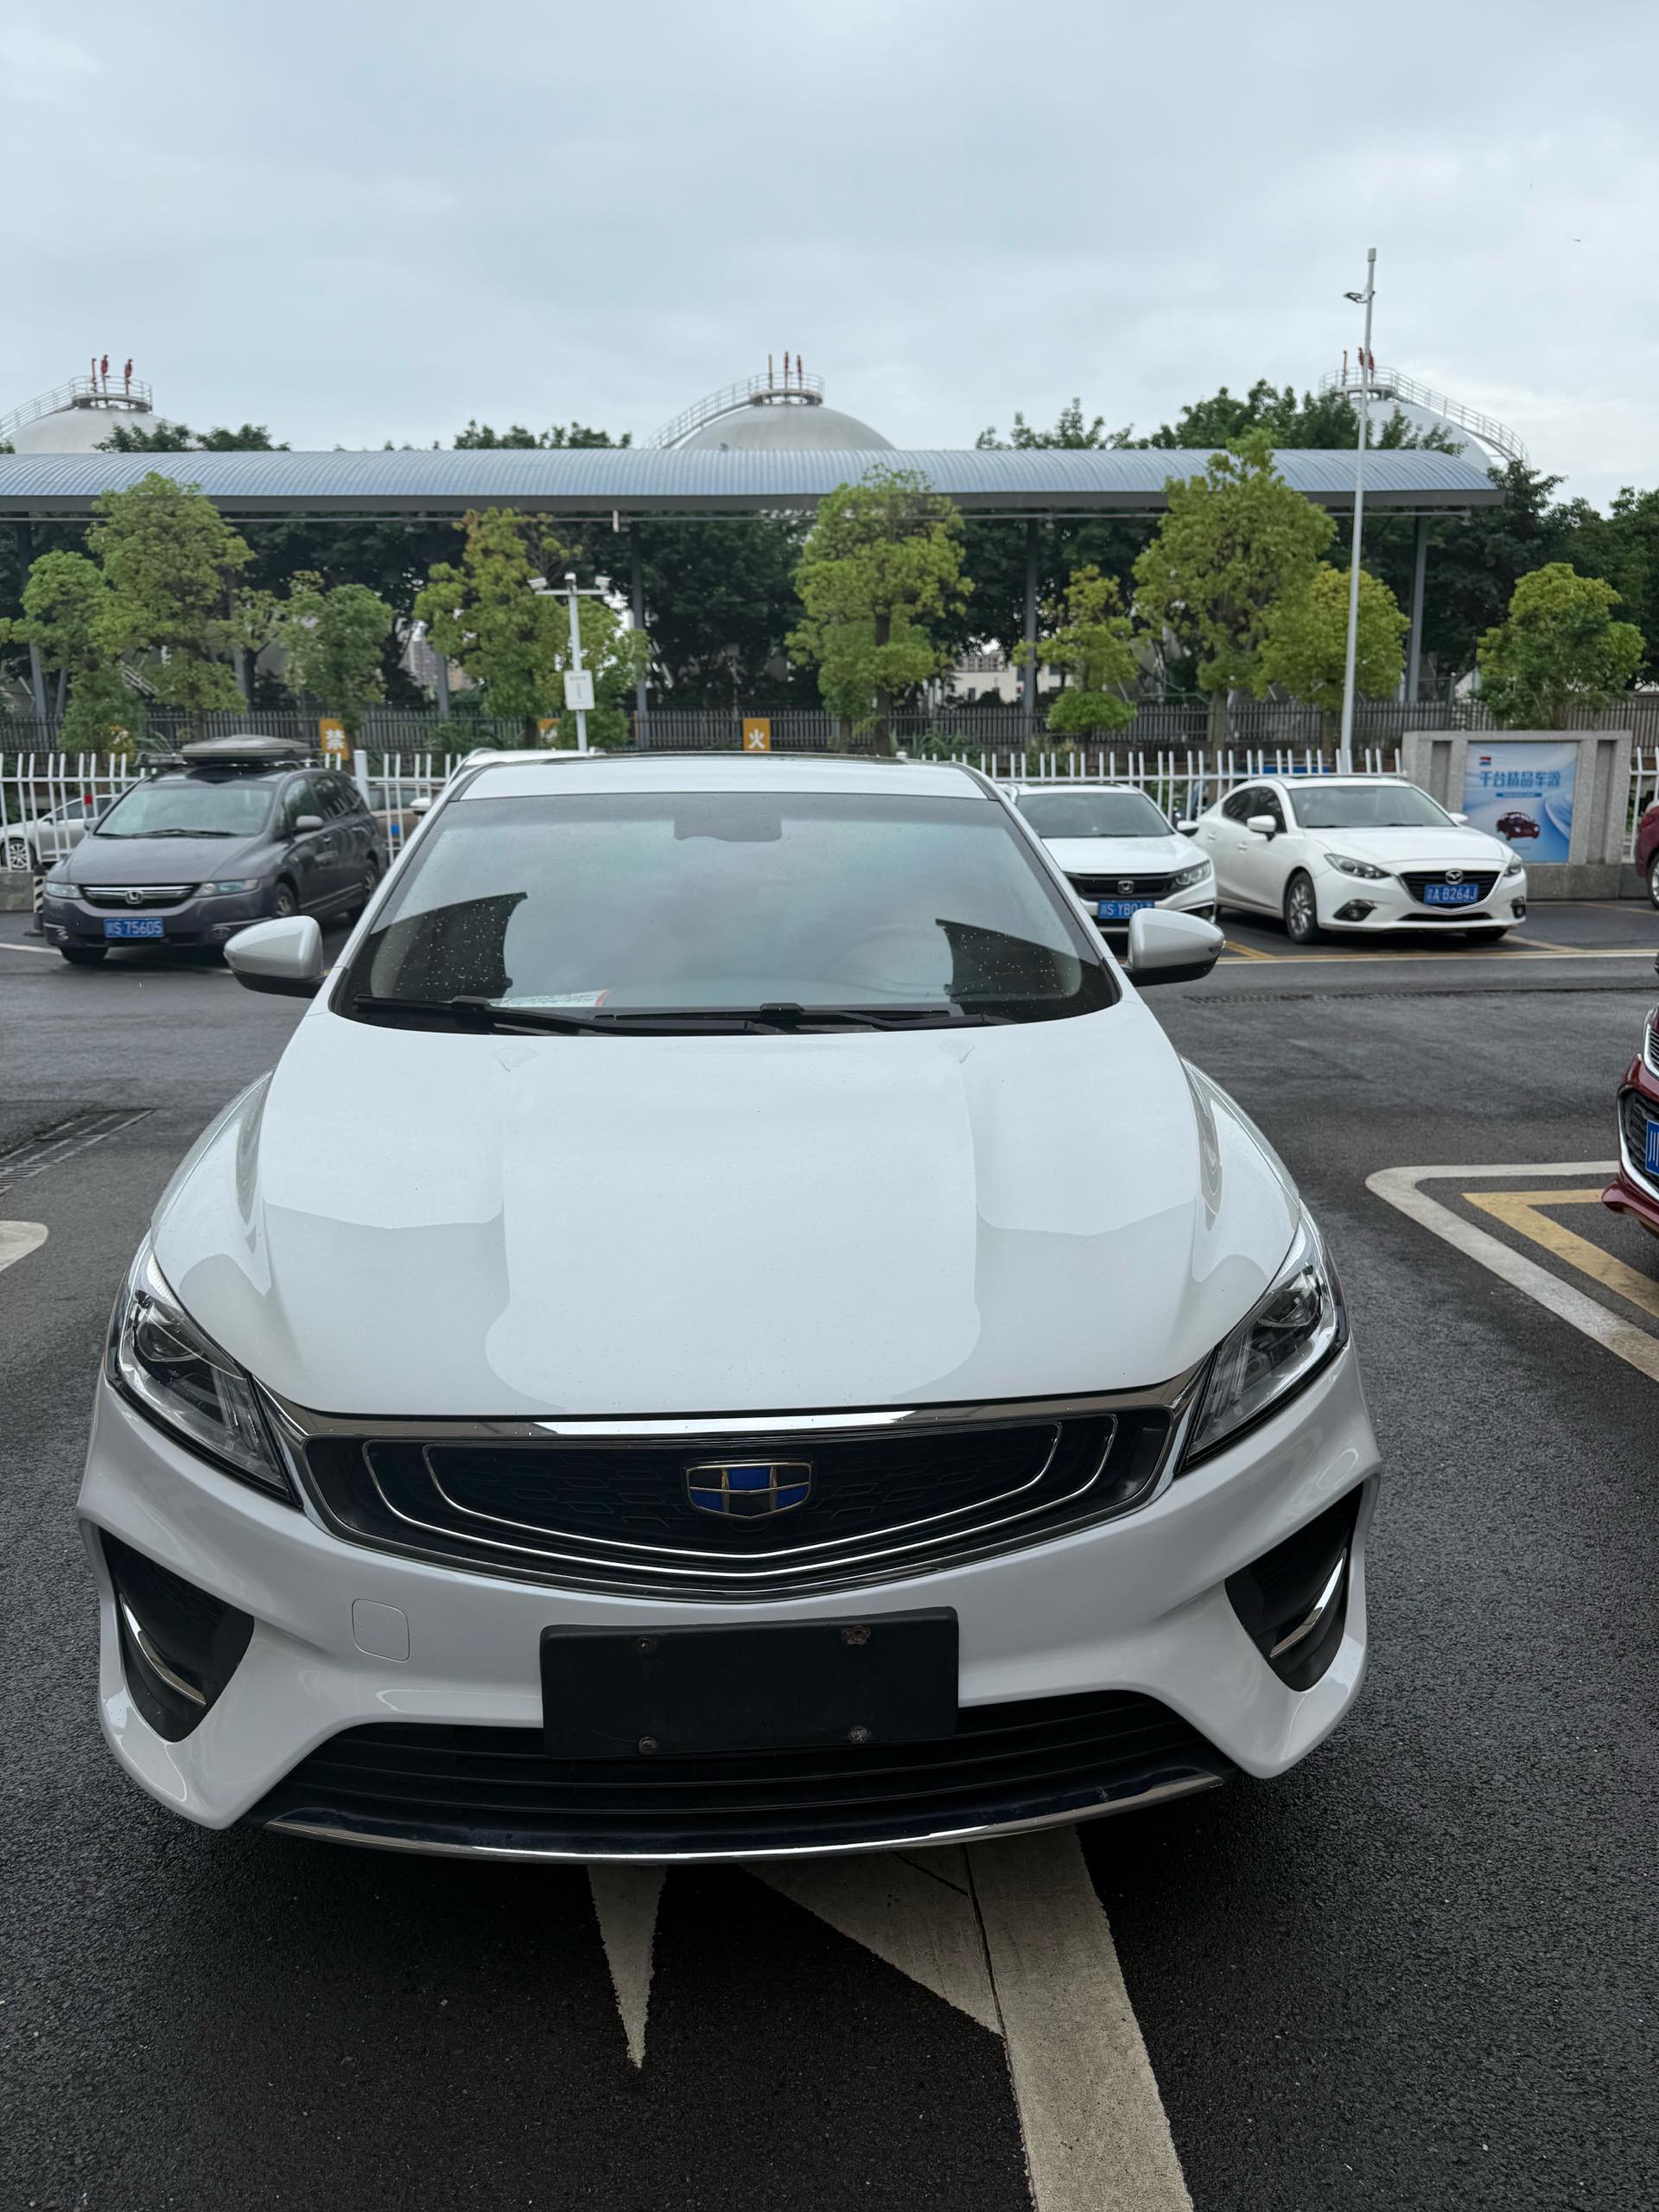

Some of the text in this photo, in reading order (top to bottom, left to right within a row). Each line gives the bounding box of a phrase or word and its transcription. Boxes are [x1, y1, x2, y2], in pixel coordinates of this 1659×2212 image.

[325, 728, 346, 750] 禁
[748, 728, 766, 749] 火
[1479, 770, 1562, 788] 千台精品车源
